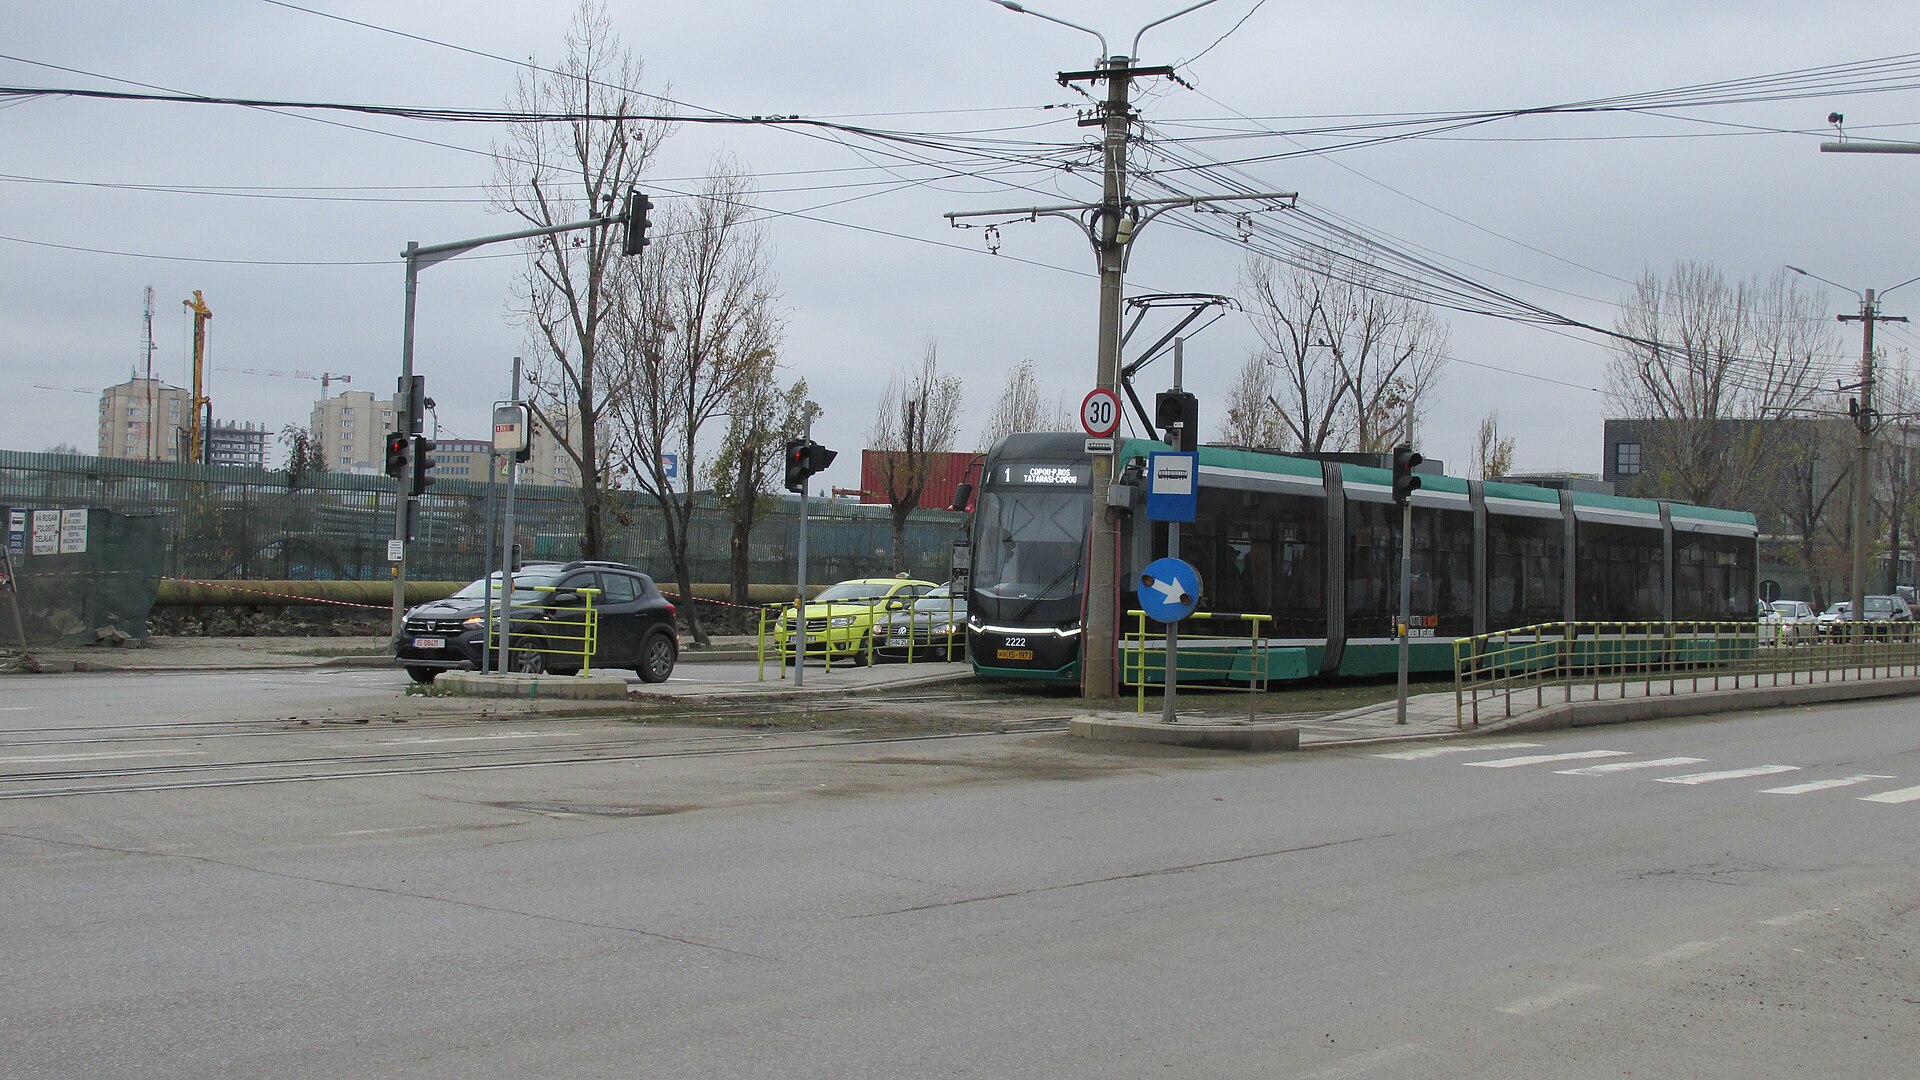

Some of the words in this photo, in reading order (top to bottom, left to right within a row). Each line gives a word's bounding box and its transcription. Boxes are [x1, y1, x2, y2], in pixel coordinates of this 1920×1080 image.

[1090, 401, 1111, 424] 30
[1004, 467, 1011, 482] 1
[1005, 637, 1026, 647] 2222
